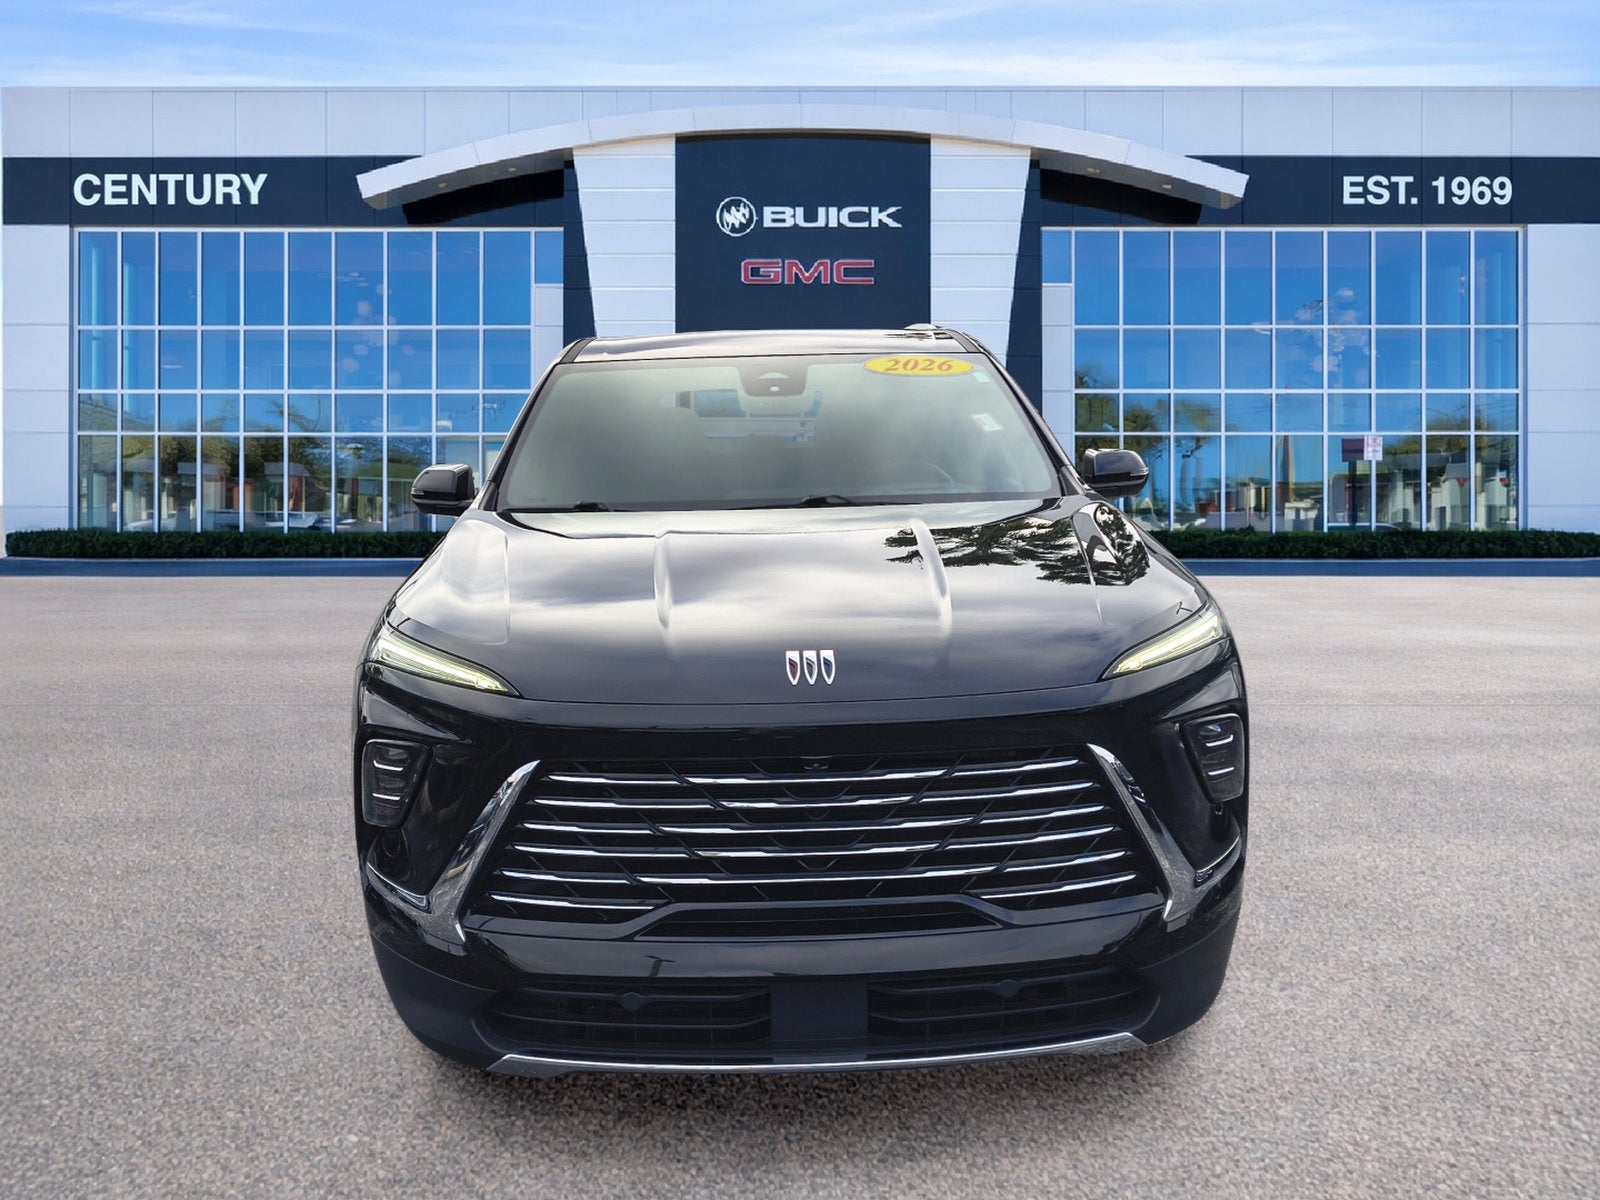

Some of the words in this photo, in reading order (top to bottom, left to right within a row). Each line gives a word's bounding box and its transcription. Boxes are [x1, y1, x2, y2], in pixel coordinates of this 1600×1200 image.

[73, 173, 268, 206] CENTURY
[1342, 175, 1418, 205] EST.
[1431, 175, 1513, 206] 1969
[762, 206, 902, 228] BUICK
[740, 258, 875, 285] GMC
[884, 358, 954, 372] 2026
